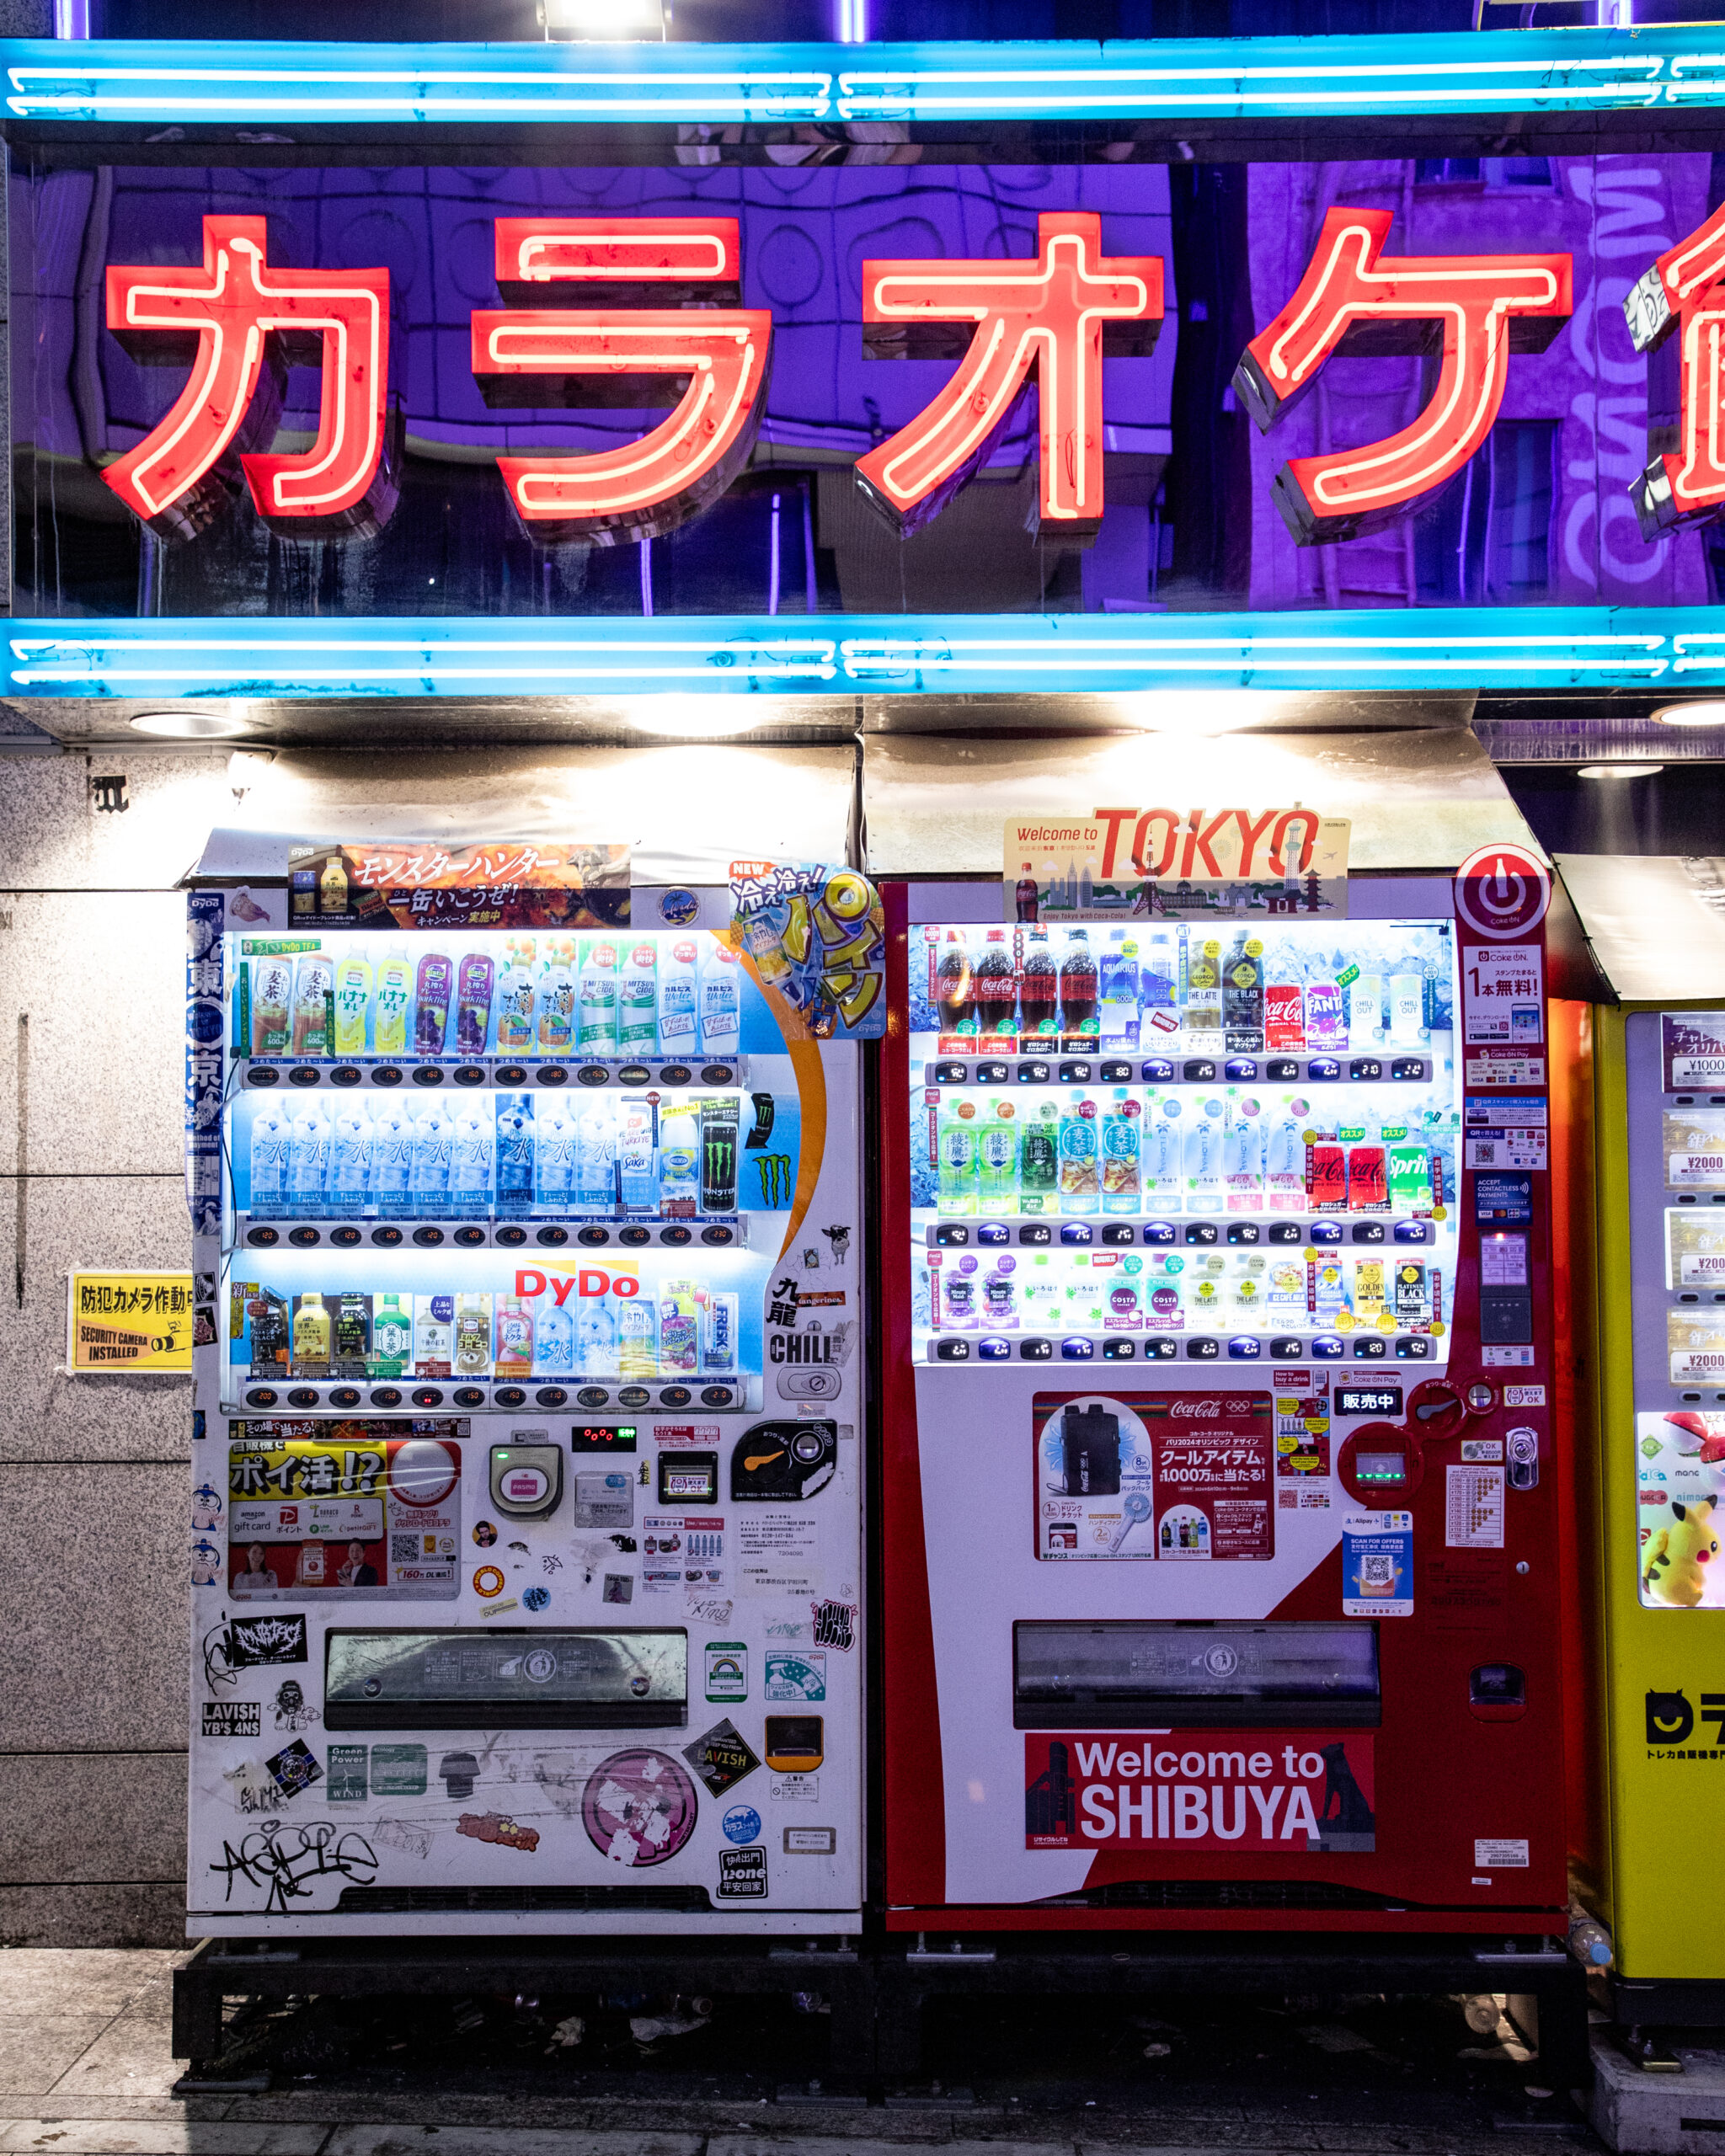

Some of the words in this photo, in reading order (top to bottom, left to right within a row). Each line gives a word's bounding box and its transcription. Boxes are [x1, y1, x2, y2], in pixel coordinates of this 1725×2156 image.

[1017, 828, 1081, 841] Welcome
[1084, 826, 1098, 841] to
[1094, 809, 1319, 878] TOKYO
[291, 846, 314, 857] DyDo
[354, 847, 560, 885] モンスターハンター
[734, 862, 765, 875] NEW
[191, 897, 219, 909] DyDo
[417, 910, 501, 926] キャンペーン実施中
[752, 926, 774, 943] 冷やし
[1102, 963, 1136, 974] AQUARIUS
[265, 970, 283, 1000] 麦茶
[305, 970, 323, 1000] 麦茶
[981, 978, 1014, 992] Coca-Cola
[1468, 967, 1538, 997] 1本無料!
[338, 990, 368, 1002] バナナ
[379, 990, 409, 1002] バナナ
[421, 988, 446, 996] グレープ
[462, 988, 488, 996] グレープ
[665, 991, 692, 1001] Water
[706, 991, 734, 1001] Water
[1188, 991, 1198, 1001] THE
[1199, 990, 1217, 1001] LATTE
[1229, 990, 1239, 999] THE
[1241, 990, 1259, 1000] BLACK
[344, 1002, 358, 1011] オ・レ
[417, 995, 448, 1006] Sparkling
[458, 995, 490, 1006] Sparkling
[1355, 999, 1375, 1007] CHILL
[1399, 999, 1418, 1007] CHILL
[1340, 1129, 1365, 1139] オススメ!
[1381, 1129, 1407, 1138] オススメ!
[950, 1133, 964, 1159] 綾鷹
[990, 1133, 1004, 1159] 綾鷹
[1071, 1129, 1086, 1155] 麦茶
[505, 1137, 532, 1162] 水
[1688, 1156, 1723, 1169] ¥2000
[515, 1261, 639, 1306] DyDo
[1358, 1283, 1384, 1292] GOLDEN
[1398, 1289, 1425, 1299] BLACK
[766, 1278, 798, 1328] 九龍
[1112, 1296, 1135, 1305] COSTA
[1153, 1296, 1178, 1305] COSTA
[624, 1312, 649, 1323] 冷やし
[716, 1306, 729, 1348] FRISK
[81, 1326, 117, 1344] SECURITY
[118, 1333, 147, 1346] CAMERA
[387, 1327, 397, 1353] 葉の茶
[505, 1333, 526, 1342] ネクター
[458, 1341, 487, 1349] コーヒー
[771, 1335, 836, 1364] CHILL
[88, 1347, 138, 1362] INSTALLED
[1689, 1355, 1725, 1367] ¥2000
[1384, 1376, 1397, 1385] Pay
[1343, 1394, 1394, 1410] 販売中
[1170, 1401, 1223, 1418] Coca-Cola
[1166, 1438, 1231, 1446] パリ2024オリンピック
[229, 1450, 384, 1497] ポイ活!?
[241, 1511, 265, 1519] amazon
[234, 1522, 250, 1533] gift
[252, 1522, 270, 1531] card
[395, 1518, 451, 1528] ダウンロードはコチラ
[276, 1525, 302, 1534] ポイント
[772, 1689, 796, 1697] 強化中!
[203, 1703, 260, 1721] LAVI$H
[204, 1721, 232, 1736] YB'$
[234, 1721, 259, 1736] 4N$
[331, 1755, 364, 1764] Power
[697, 1748, 747, 1767] LAVISH
[1074, 1742, 1274, 1778] Welcome
[1281, 1745, 1325, 1779] to
[1081, 1784, 1322, 1840] SHIBUYA
[723, 1881, 762, 1892] 平安回家
